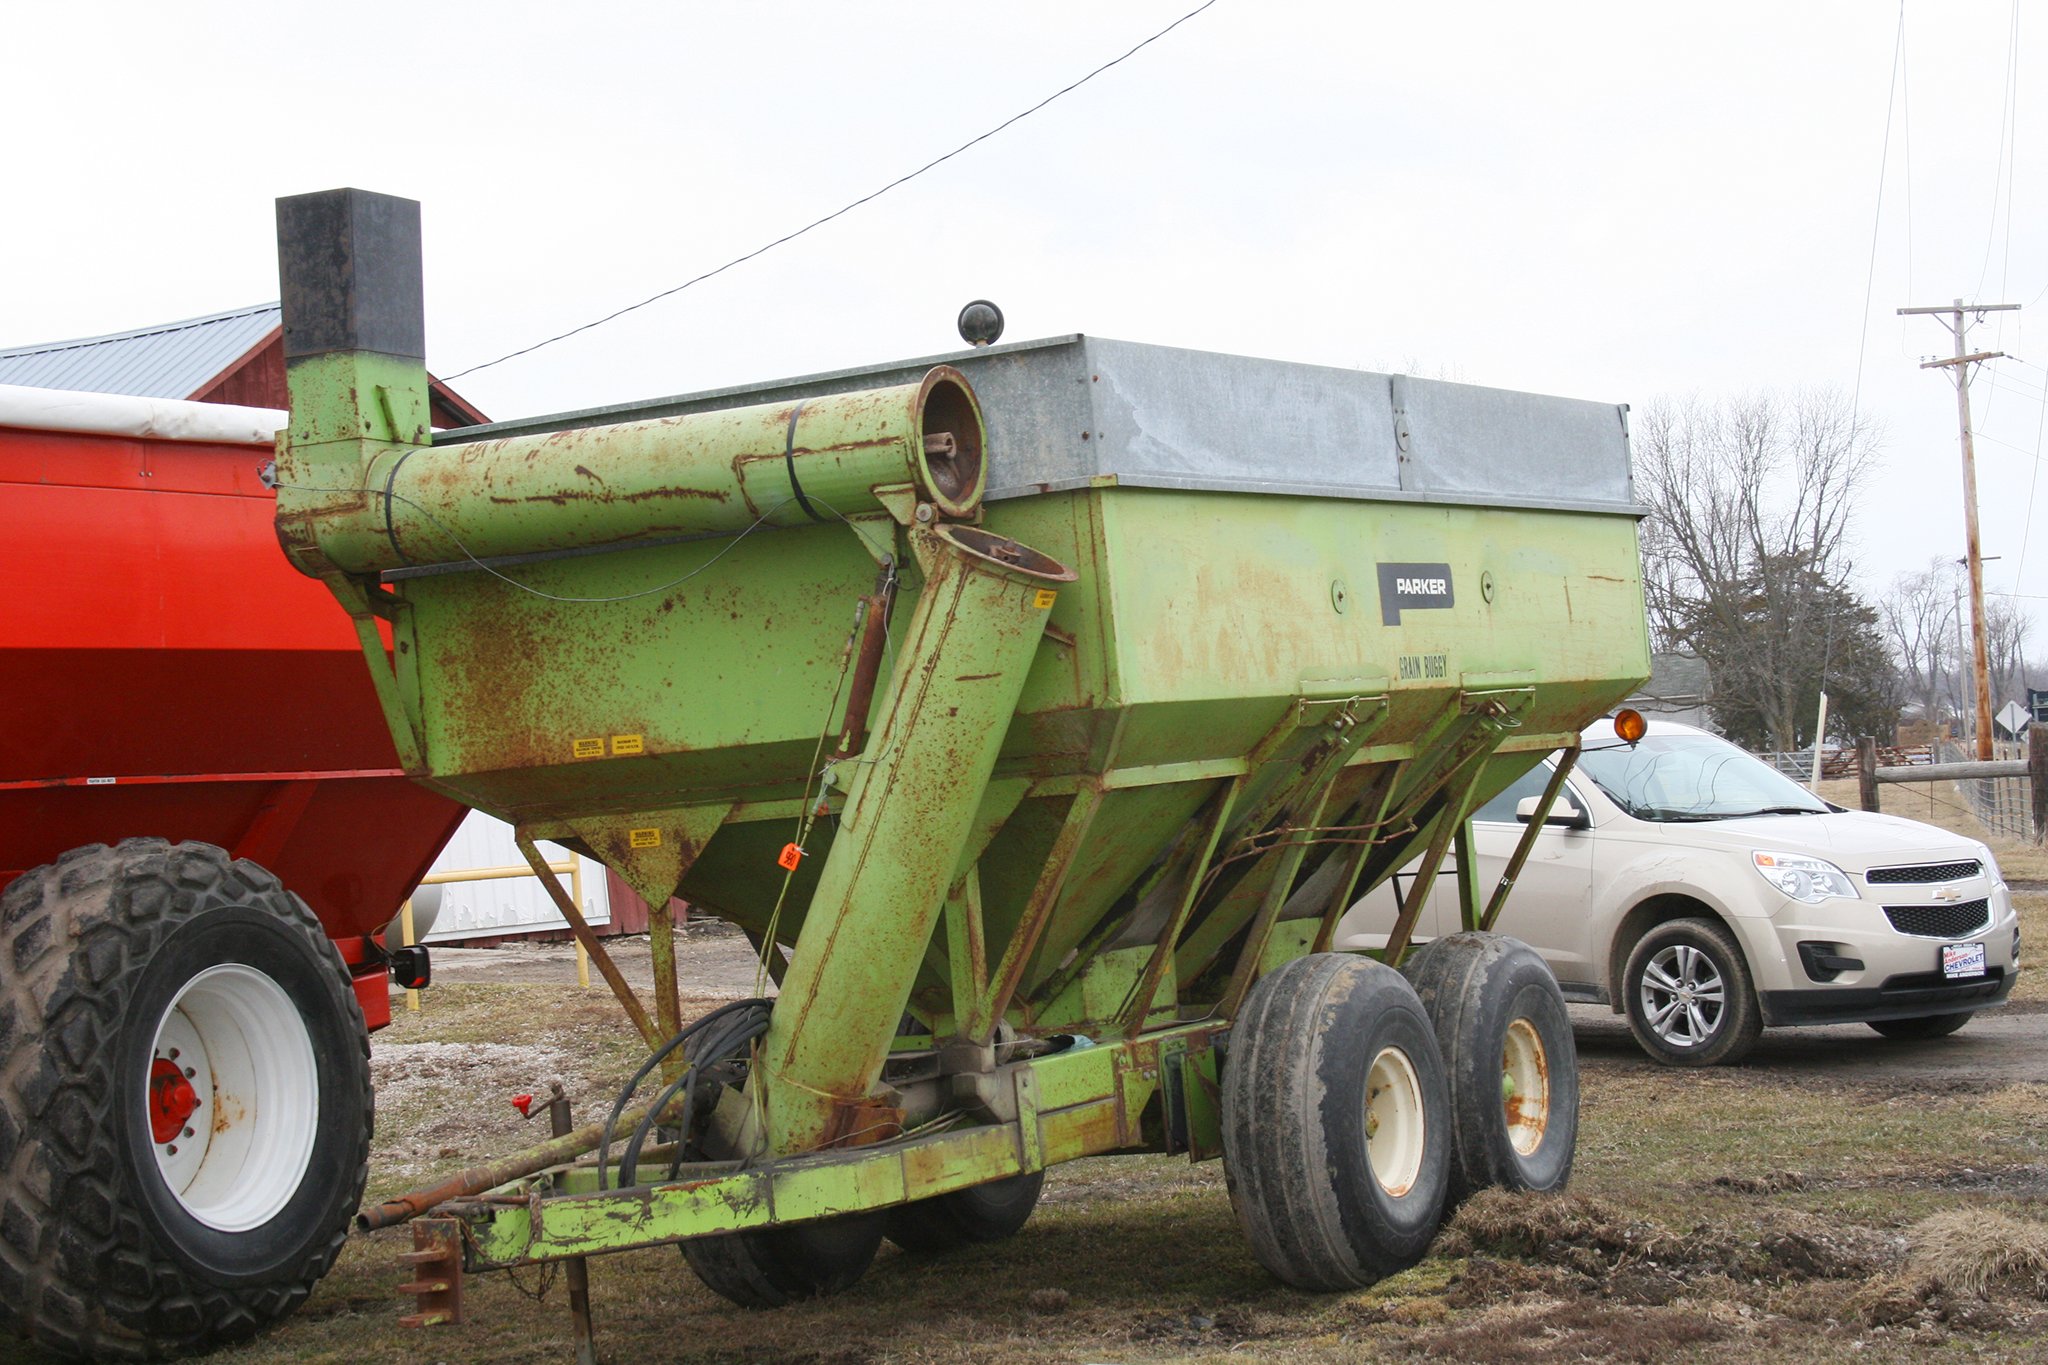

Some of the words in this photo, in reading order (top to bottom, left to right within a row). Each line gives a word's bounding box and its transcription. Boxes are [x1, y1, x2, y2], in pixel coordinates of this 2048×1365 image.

[1396, 578, 1447, 595] PARKER
[1399, 656, 1421, 680] GRAIN
[1424, 655, 1447, 678] BUGGY
[1945, 952, 1984, 971] CHEVROLET
